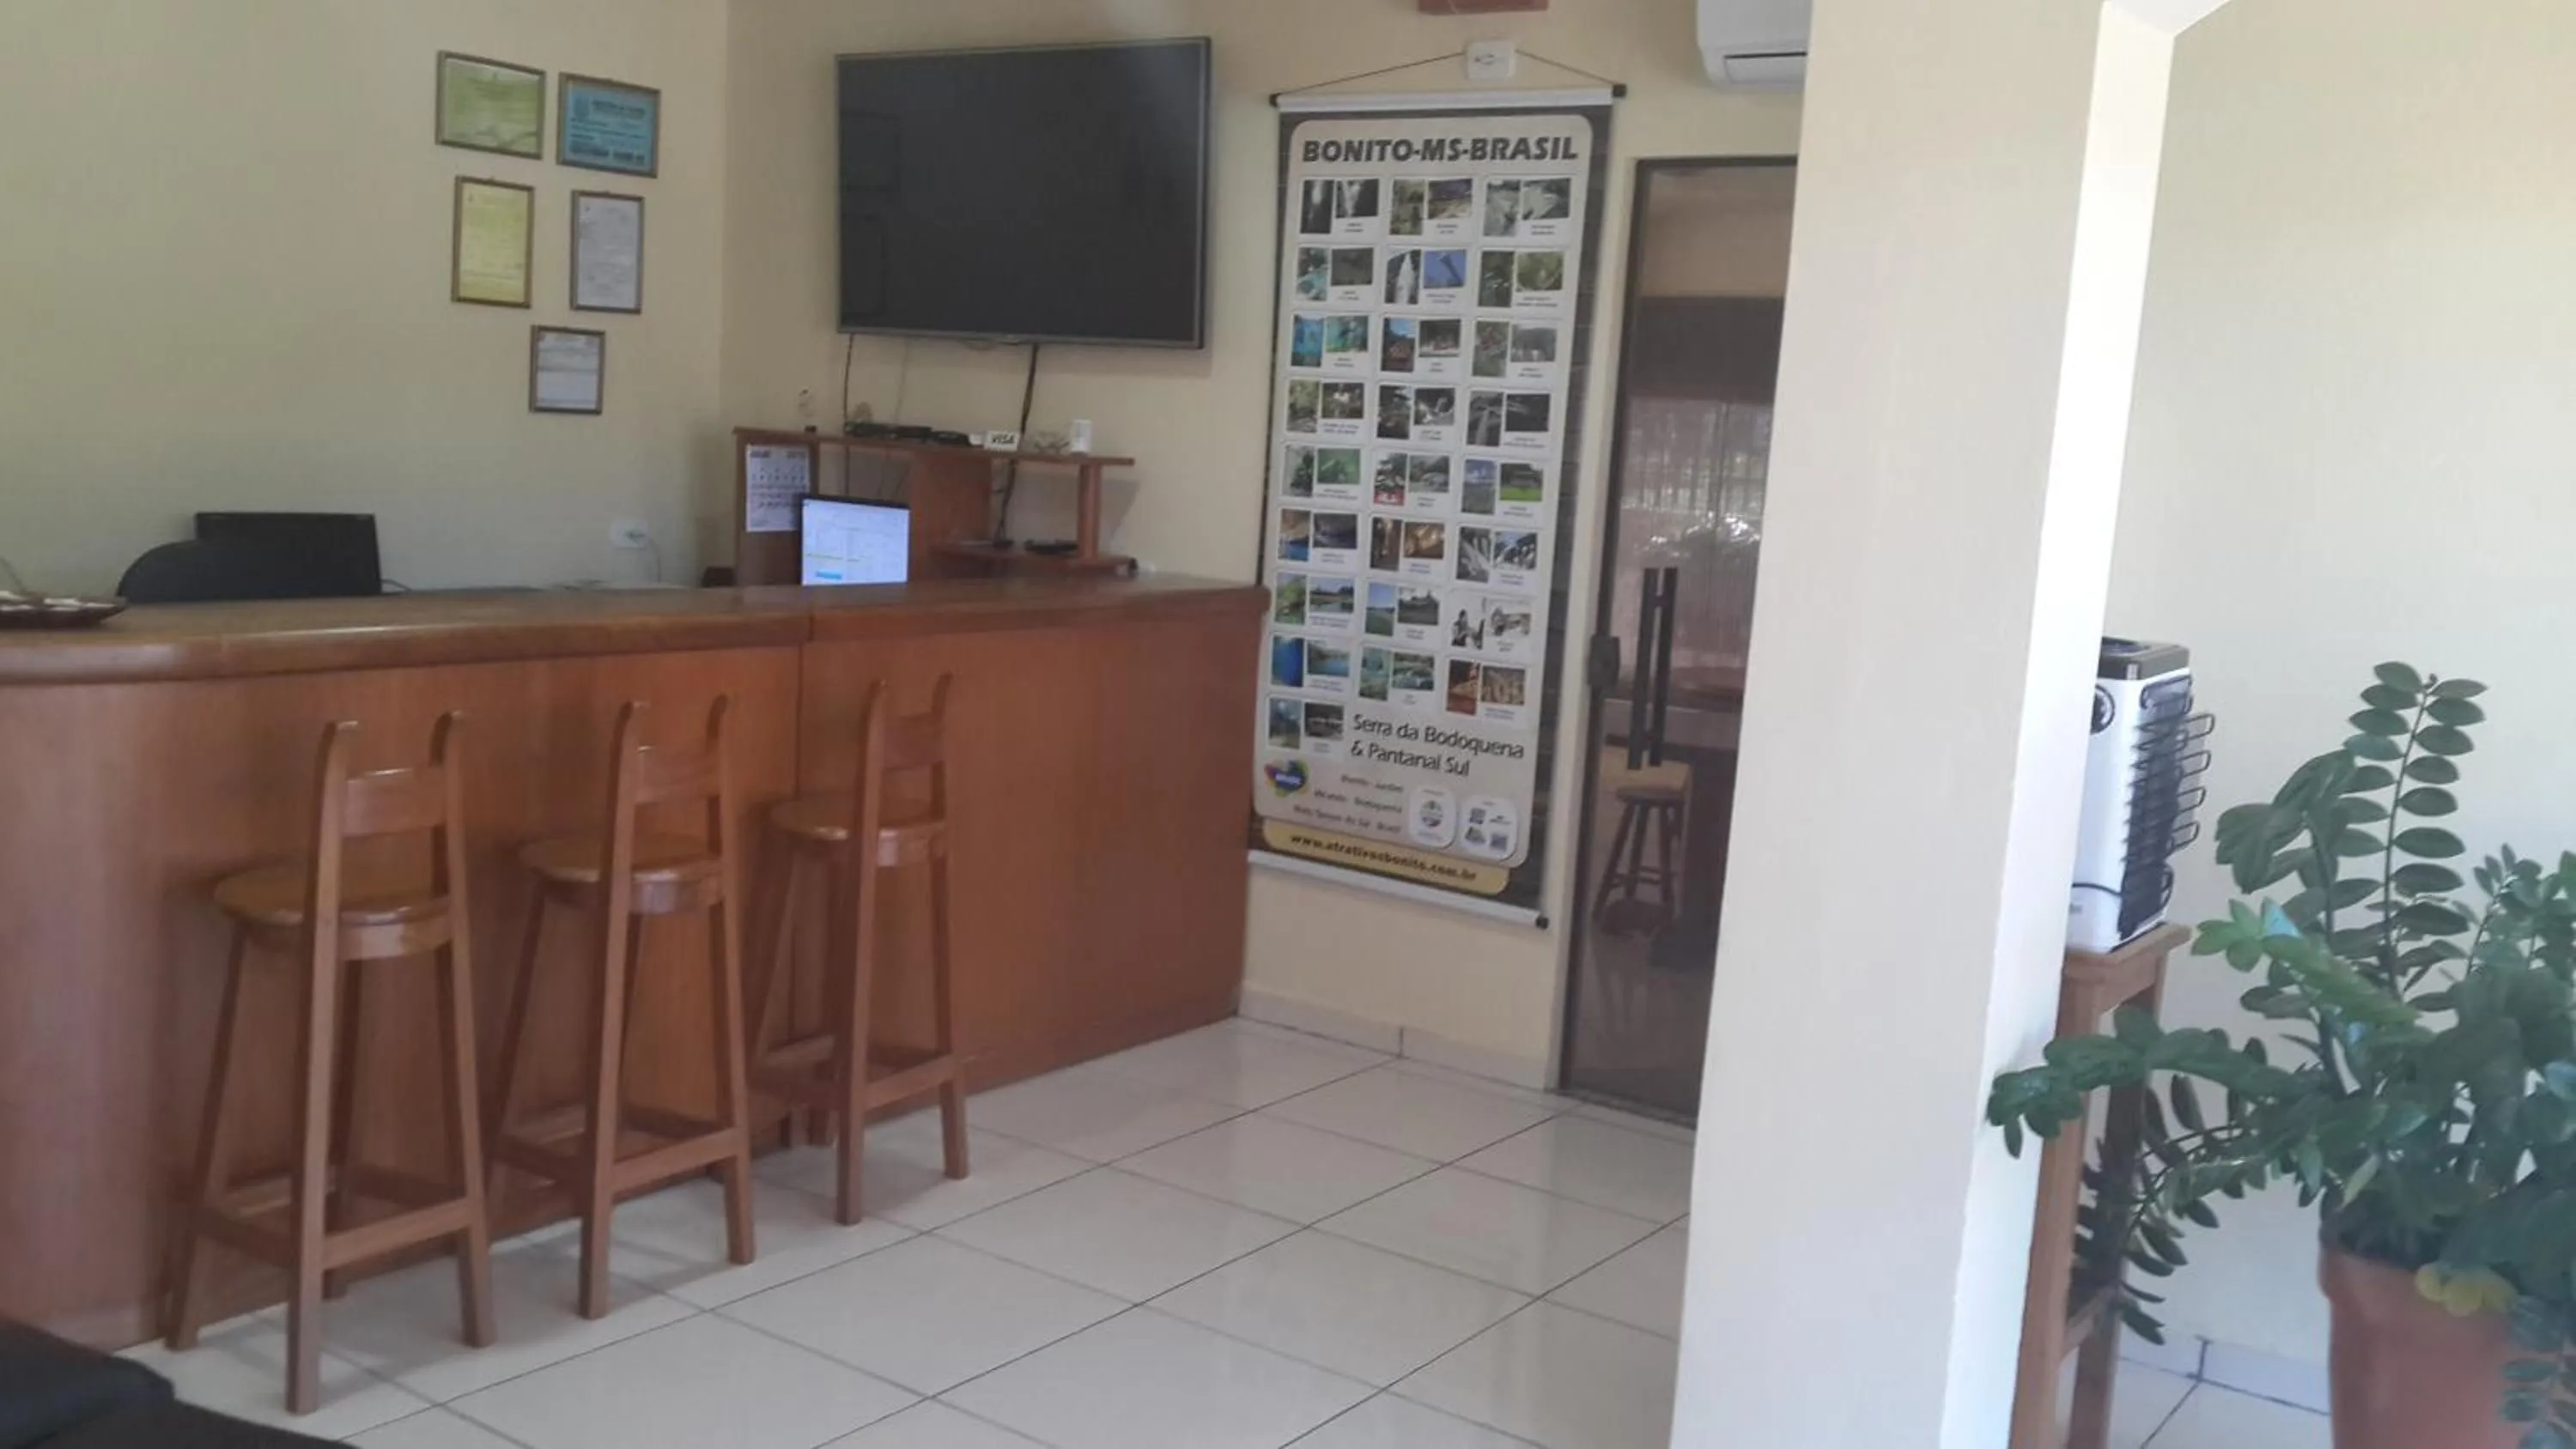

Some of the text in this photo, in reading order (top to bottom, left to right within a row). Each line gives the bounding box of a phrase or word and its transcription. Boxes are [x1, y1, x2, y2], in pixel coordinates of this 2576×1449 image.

[1303, 136, 1578, 163] BONITO-MS-BRASIL
[1352, 713, 1524, 759] Serra da Bodoquena
[1351, 740, 1364, 757] &
[1368, 742, 1441, 770] Pantanal
[1443, 755, 1470, 776] Sul
